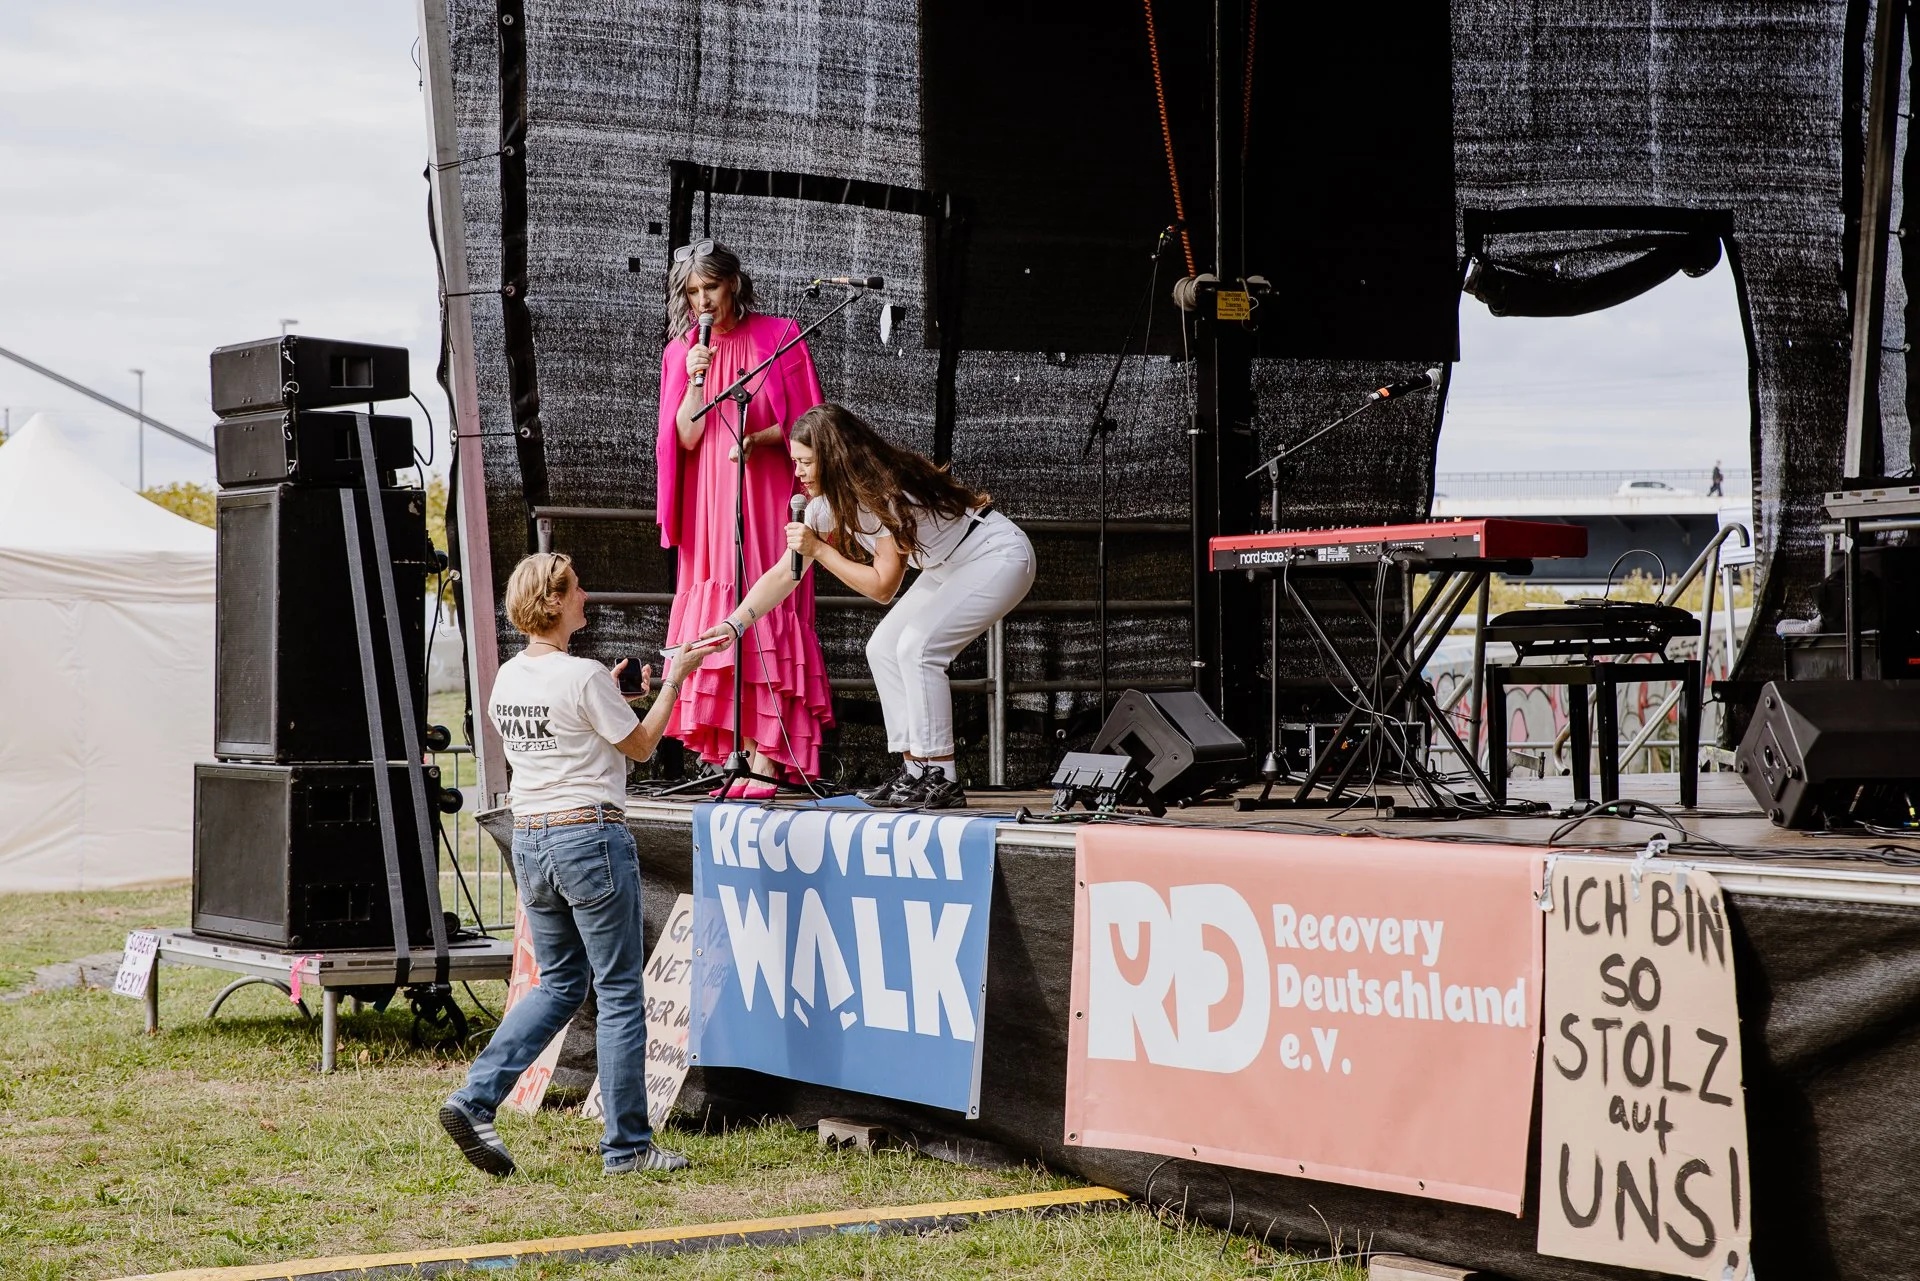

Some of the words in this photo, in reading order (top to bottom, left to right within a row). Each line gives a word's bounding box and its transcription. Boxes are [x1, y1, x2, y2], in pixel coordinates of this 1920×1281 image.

[1239, 551, 1260, 565] nord
[1260, 550, 1284, 564] stage
[496, 704, 550, 718] RECOVERY
[498, 718, 555, 740] WALK
[527, 739, 556, 751] 2025
[709, 804, 978, 881] RECOVERY
[1272, 903, 1444, 967] Recovery
[1562, 874, 1628, 938] ICH
[1650, 880, 1726, 971] BIN
[718, 885, 976, 1042] WALK
[1088, 881, 1271, 1074] RD
[1600, 953, 1662, 1012] SO
[643, 996, 675, 1027] BER
[1277, 963, 1526, 1028] Deutschland
[1279, 1027, 1352, 1075] e.V.
[1552, 1012, 1734, 1107] STOLZ
[645, 1073, 677, 1103] INEM
[1558, 1141, 1742, 1270] UNS!
